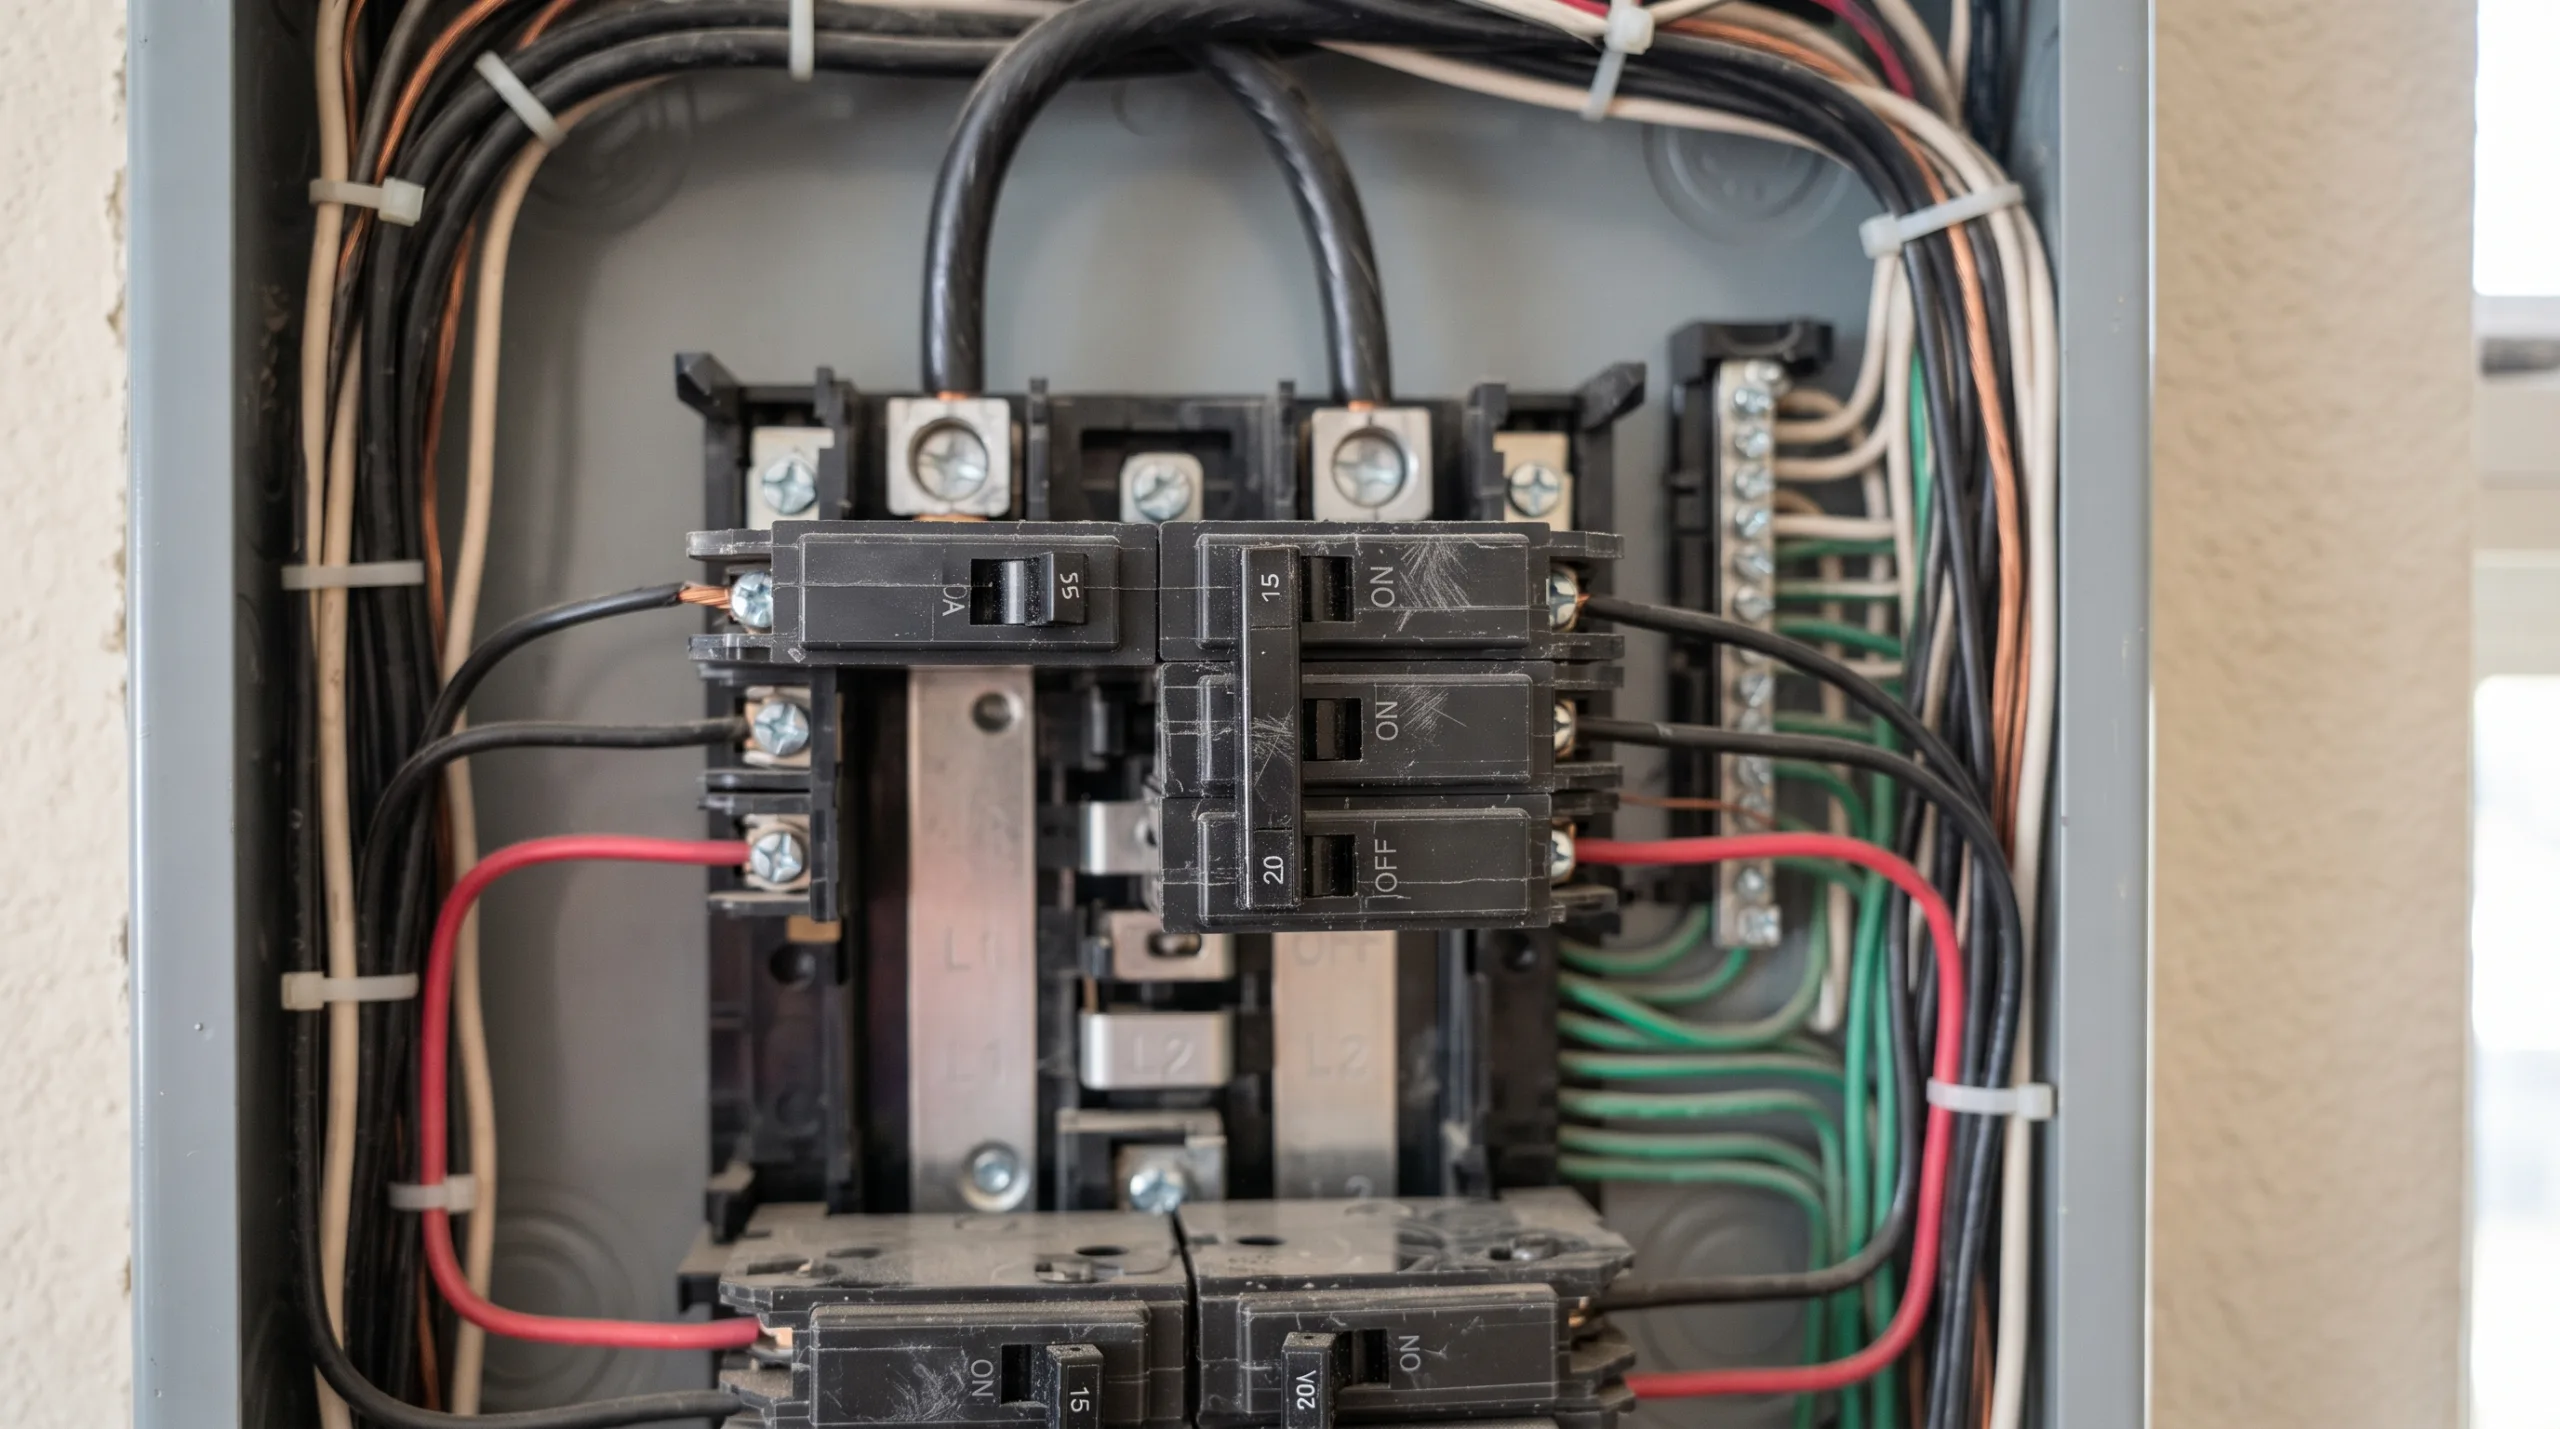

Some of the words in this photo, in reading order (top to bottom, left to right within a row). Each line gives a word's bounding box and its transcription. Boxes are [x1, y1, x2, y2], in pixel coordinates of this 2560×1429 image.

[1260, 573, 1281, 602] 15
[1370, 566, 1395, 608] ON
[1375, 701, 1399, 741] ON
[1263, 855, 1284, 885] 20
[1375, 839, 1398, 893] OFF
[1398, 1335, 1421, 1372] ON
[970, 1359, 994, 1397] ON
[1069, 1386, 1090, 1413] 15
